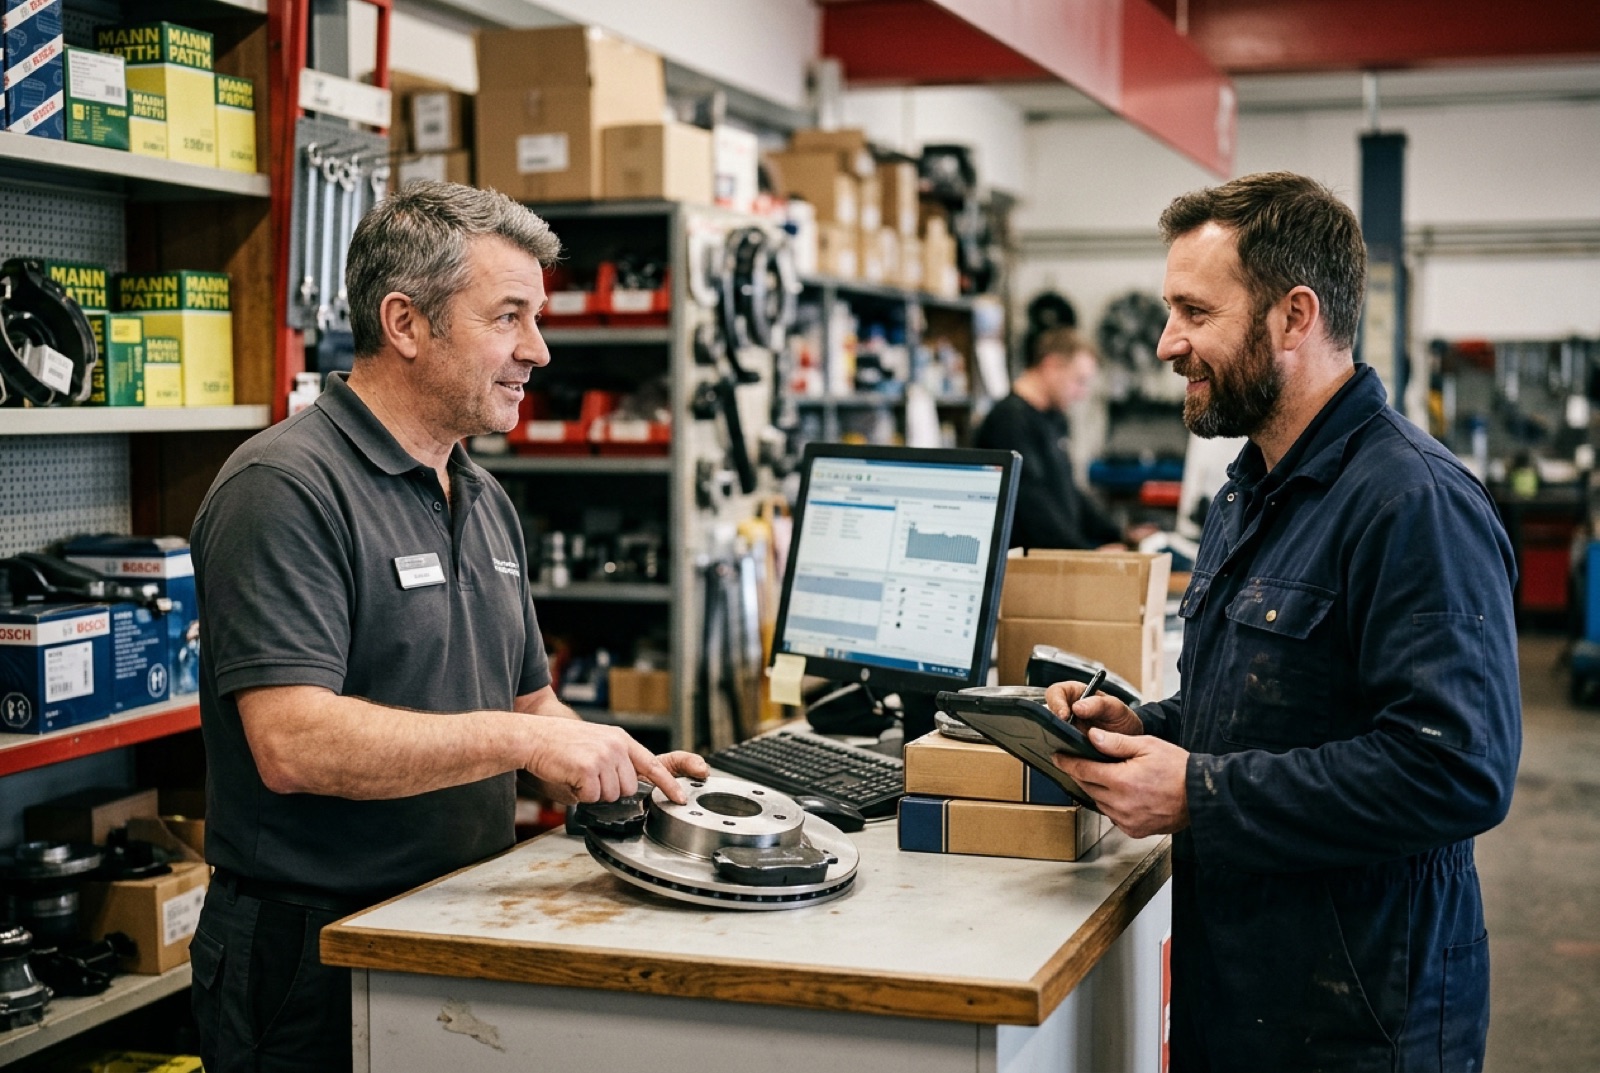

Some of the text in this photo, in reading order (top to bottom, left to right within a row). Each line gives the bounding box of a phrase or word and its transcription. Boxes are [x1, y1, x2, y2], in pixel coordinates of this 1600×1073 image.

[168, 28, 211, 53] MANN
[51, 267, 105, 287] MANN
[121, 277, 178, 291] MANN
[186, 276, 229, 292] MANN
[121, 293, 178, 307] PATTH
